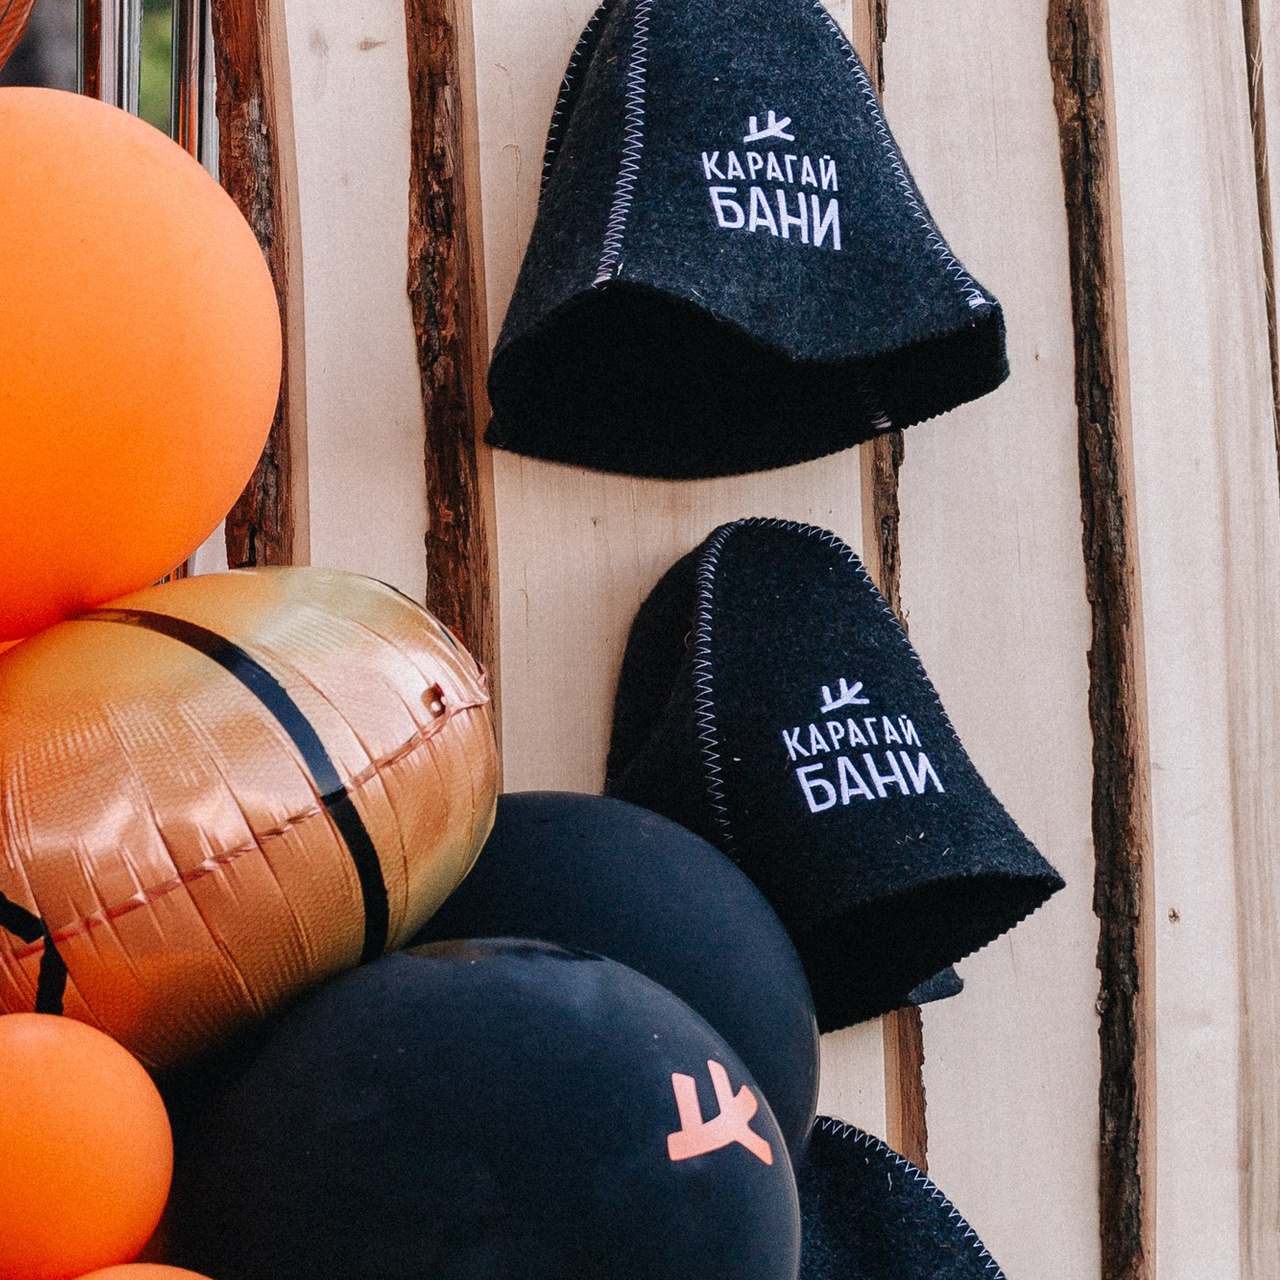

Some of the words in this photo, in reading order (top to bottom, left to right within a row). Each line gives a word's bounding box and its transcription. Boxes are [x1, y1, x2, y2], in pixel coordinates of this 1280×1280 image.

[701, 150, 838, 191] КАРАГАЙ
[708, 186, 841, 250] БАНИ
[782, 714, 922, 761] КАРАГАЙ
[795, 750, 945, 813] БАНИ
